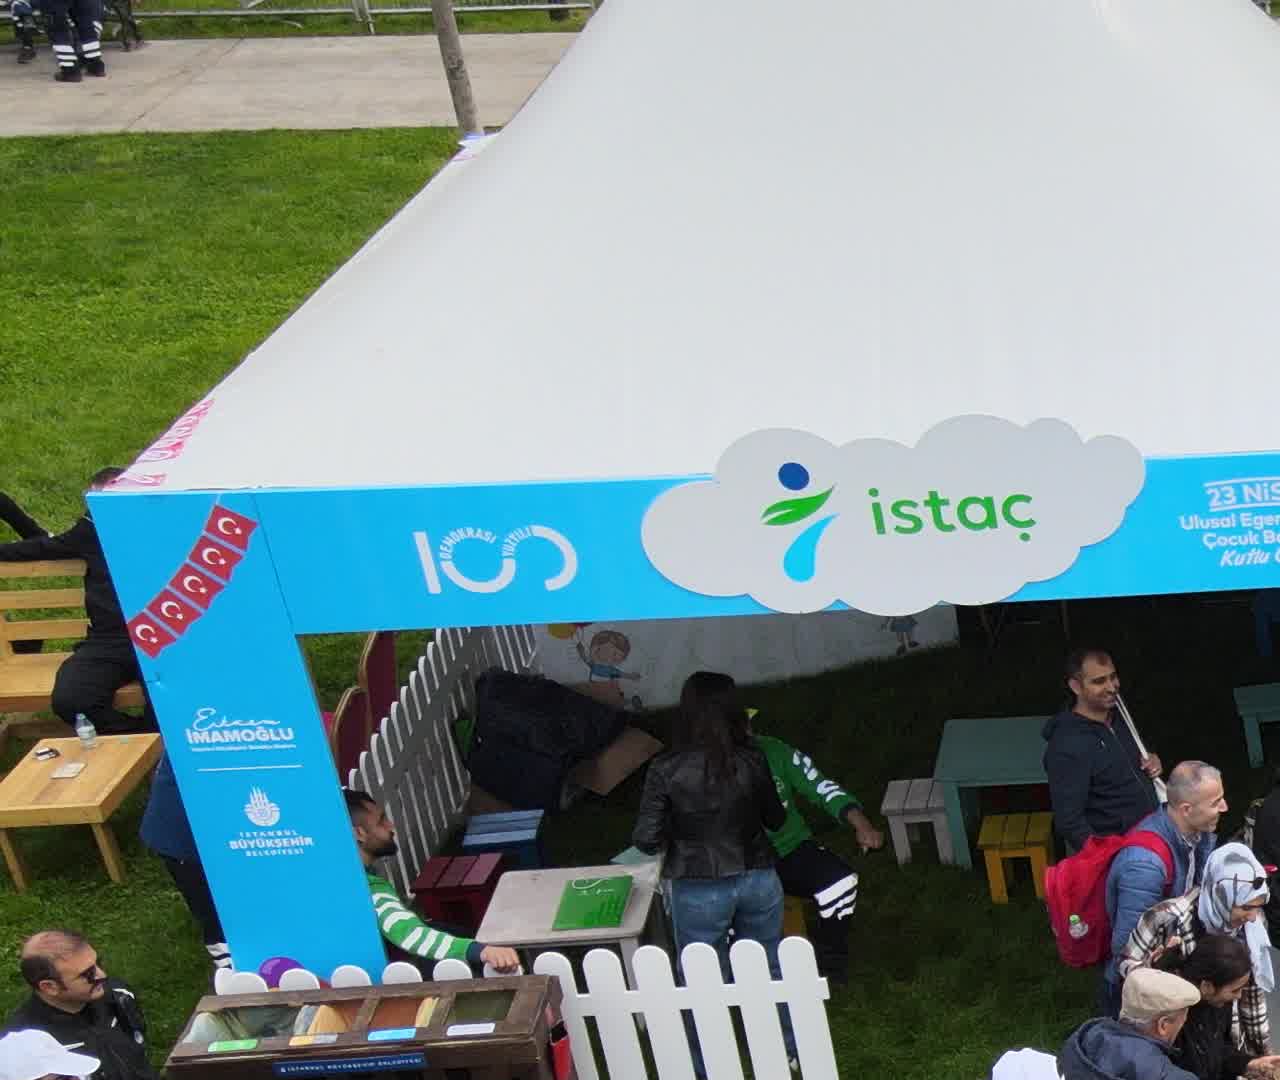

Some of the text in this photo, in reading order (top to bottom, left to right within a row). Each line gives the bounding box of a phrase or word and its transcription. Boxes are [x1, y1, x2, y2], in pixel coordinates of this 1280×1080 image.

[1207, 486, 1236, 508] 23
[868, 487, 1036, 542] istaç
[1180, 513, 1236, 530] Ulusal
[1203, 531, 1259, 550] Çocuk
[1221, 548, 1270, 567] Kutlu
